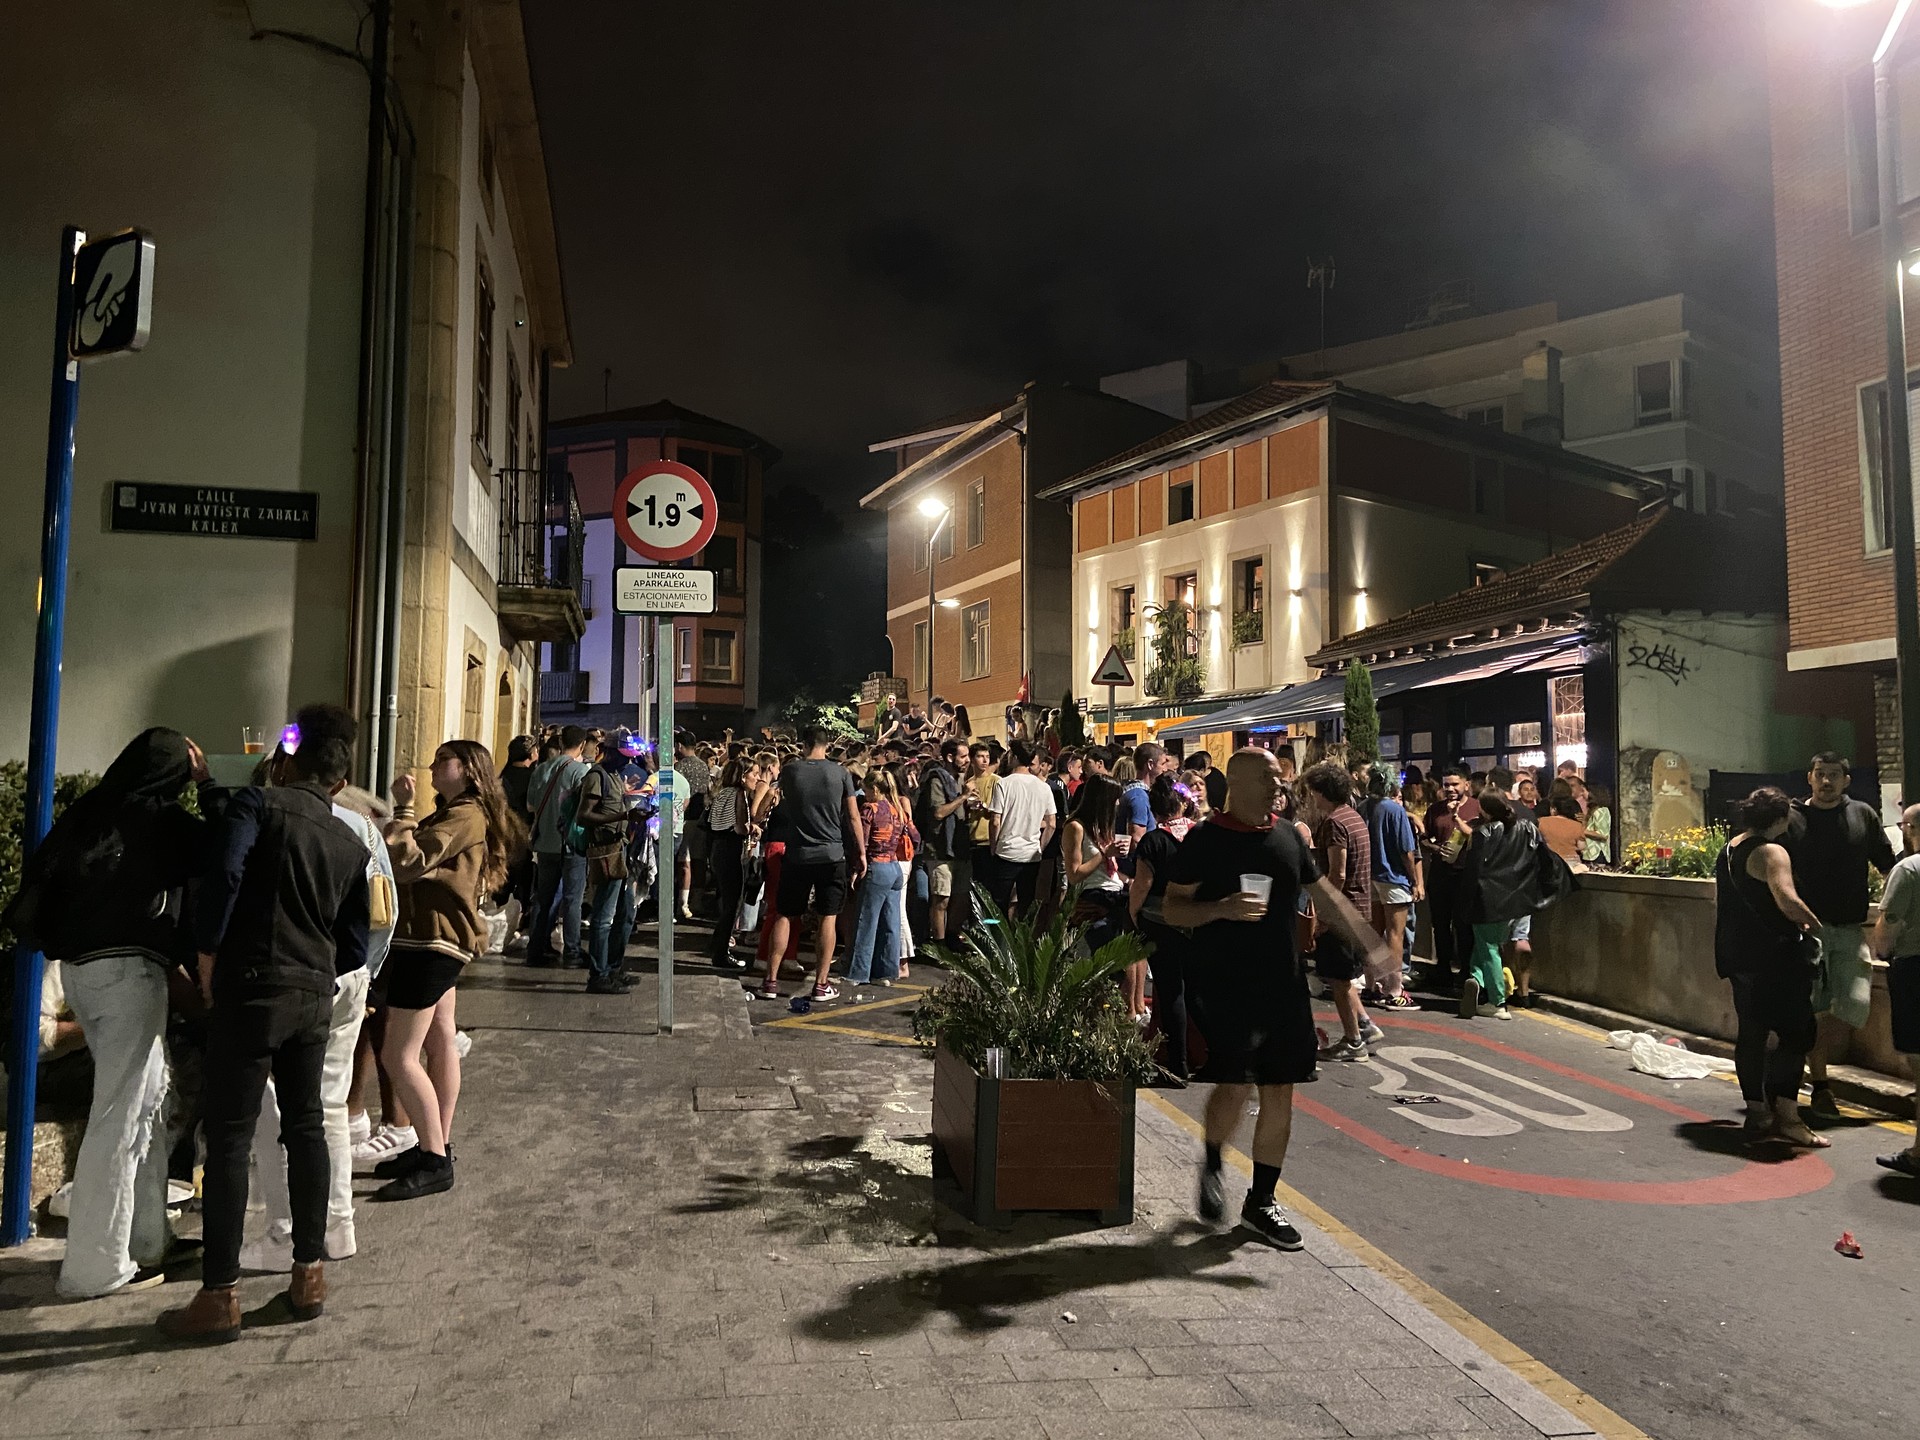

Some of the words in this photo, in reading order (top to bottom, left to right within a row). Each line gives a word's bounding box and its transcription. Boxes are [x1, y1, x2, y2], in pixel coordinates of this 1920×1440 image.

[198, 490, 235, 504] CALLE
[258, 508, 310, 522] ZABALA
[191, 520, 239, 534] KALEA
[646, 571, 685, 580] LINEAKO
[633, 580, 698, 588] APARKALEKUA
[623, 592, 708, 601] ESTACIONAMIENTO
[646, 601, 659, 609] EN
[660, 601, 686, 609] LINEA
[1358, 1046, 1634, 1136] 30
